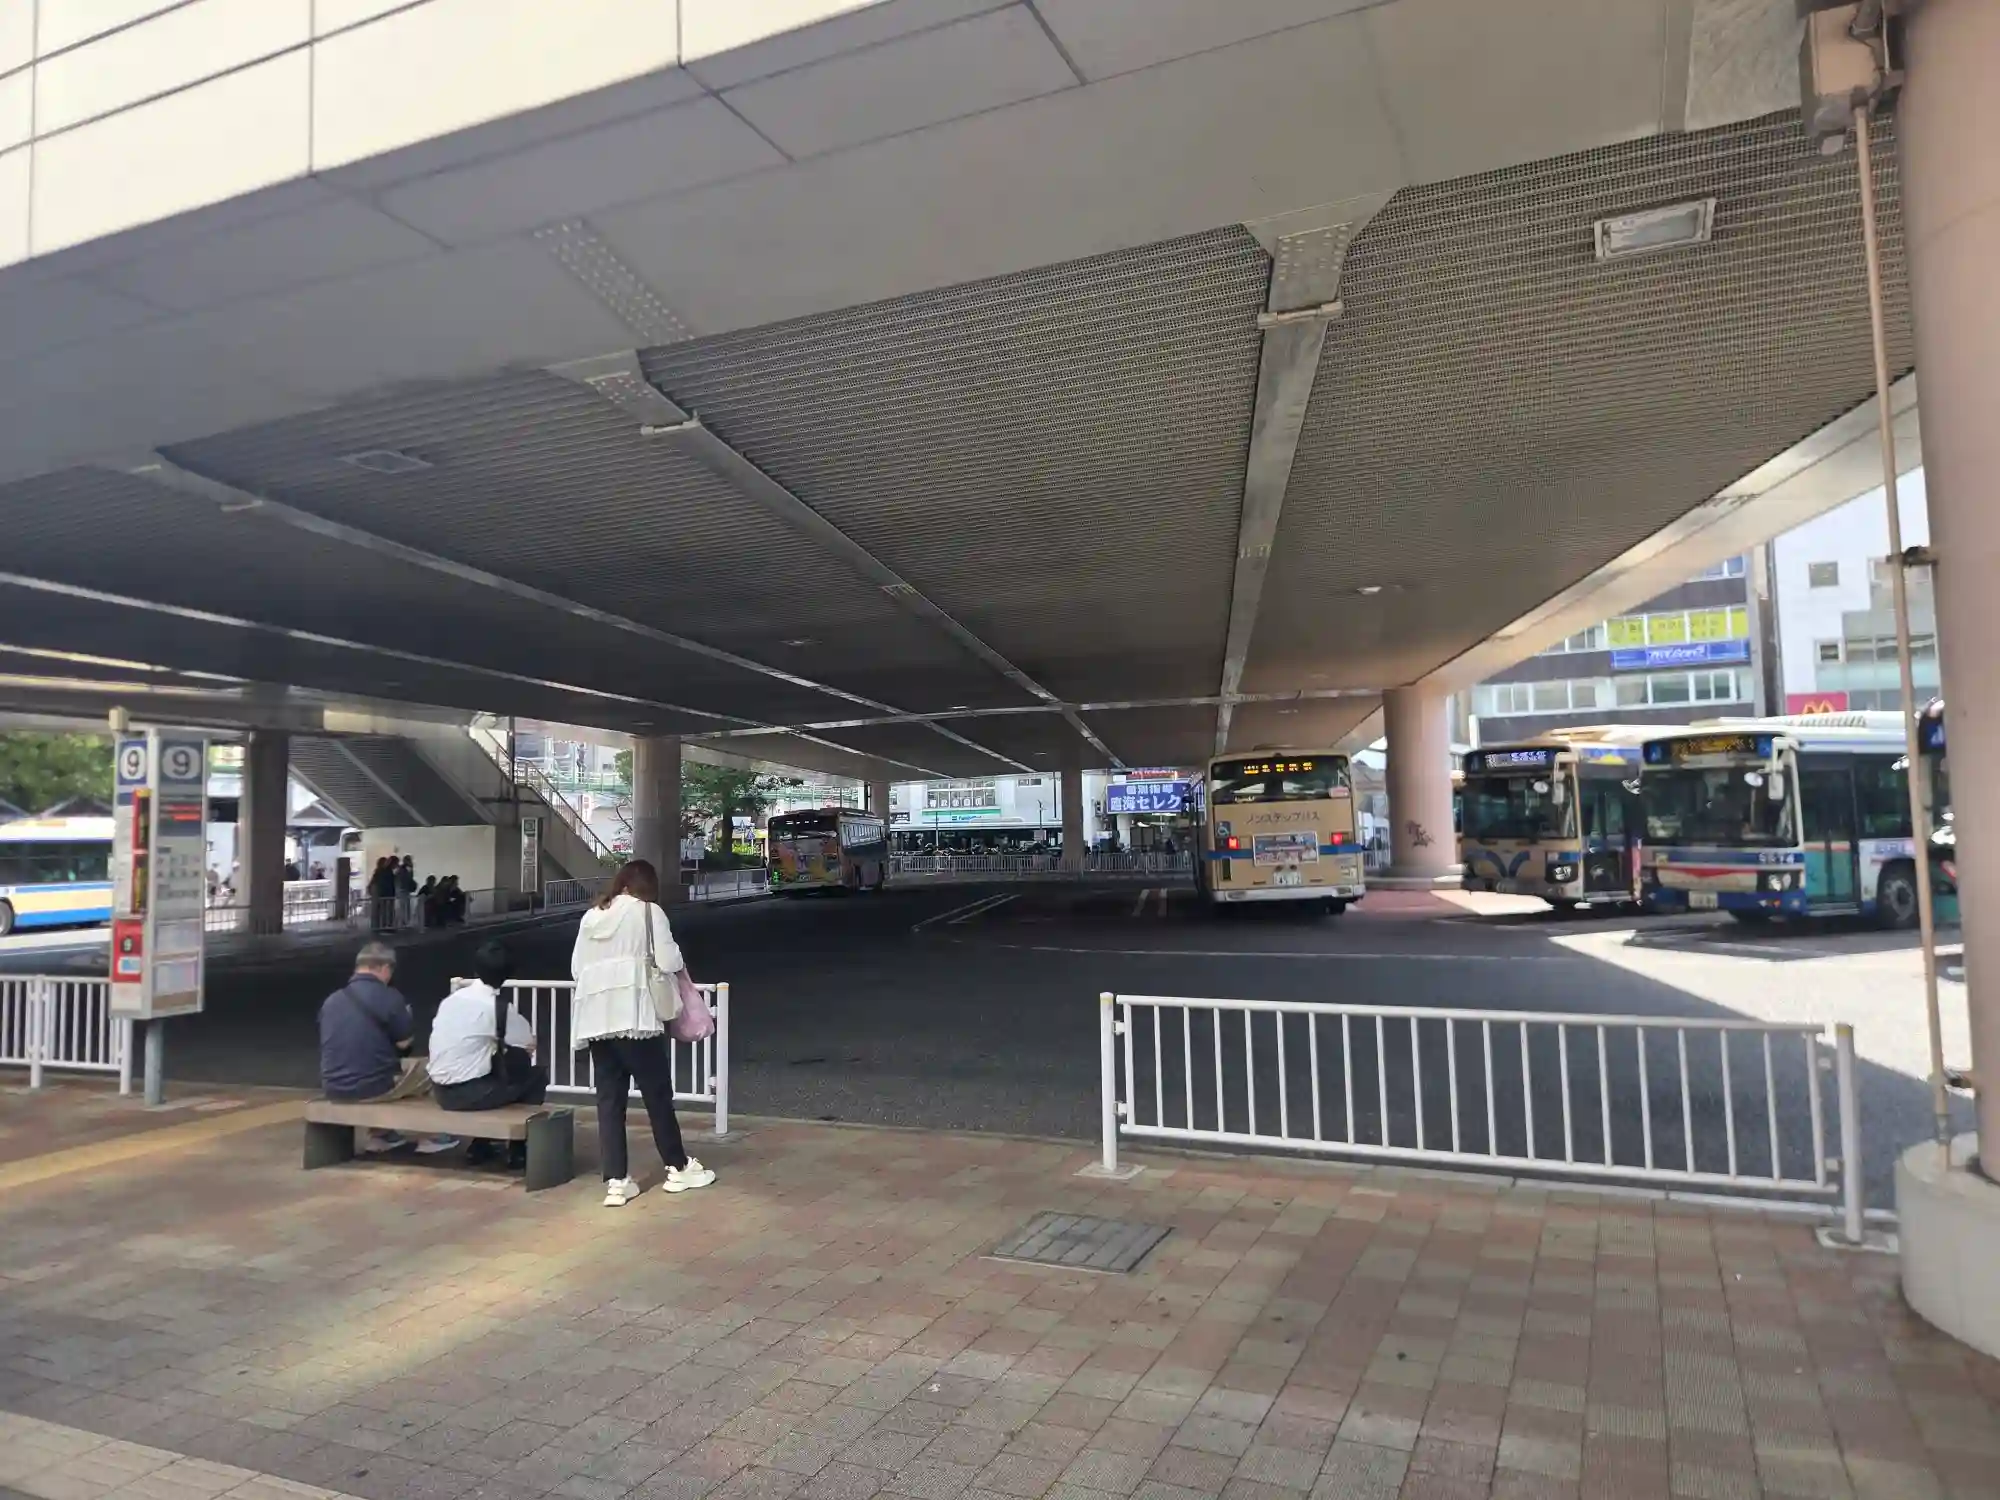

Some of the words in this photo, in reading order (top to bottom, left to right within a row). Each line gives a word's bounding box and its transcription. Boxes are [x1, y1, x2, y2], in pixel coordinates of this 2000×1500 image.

[127, 749, 139, 777] 9
[172, 749, 191, 777] 9
[1246, 810, 1320, 825] ノンステップバス
